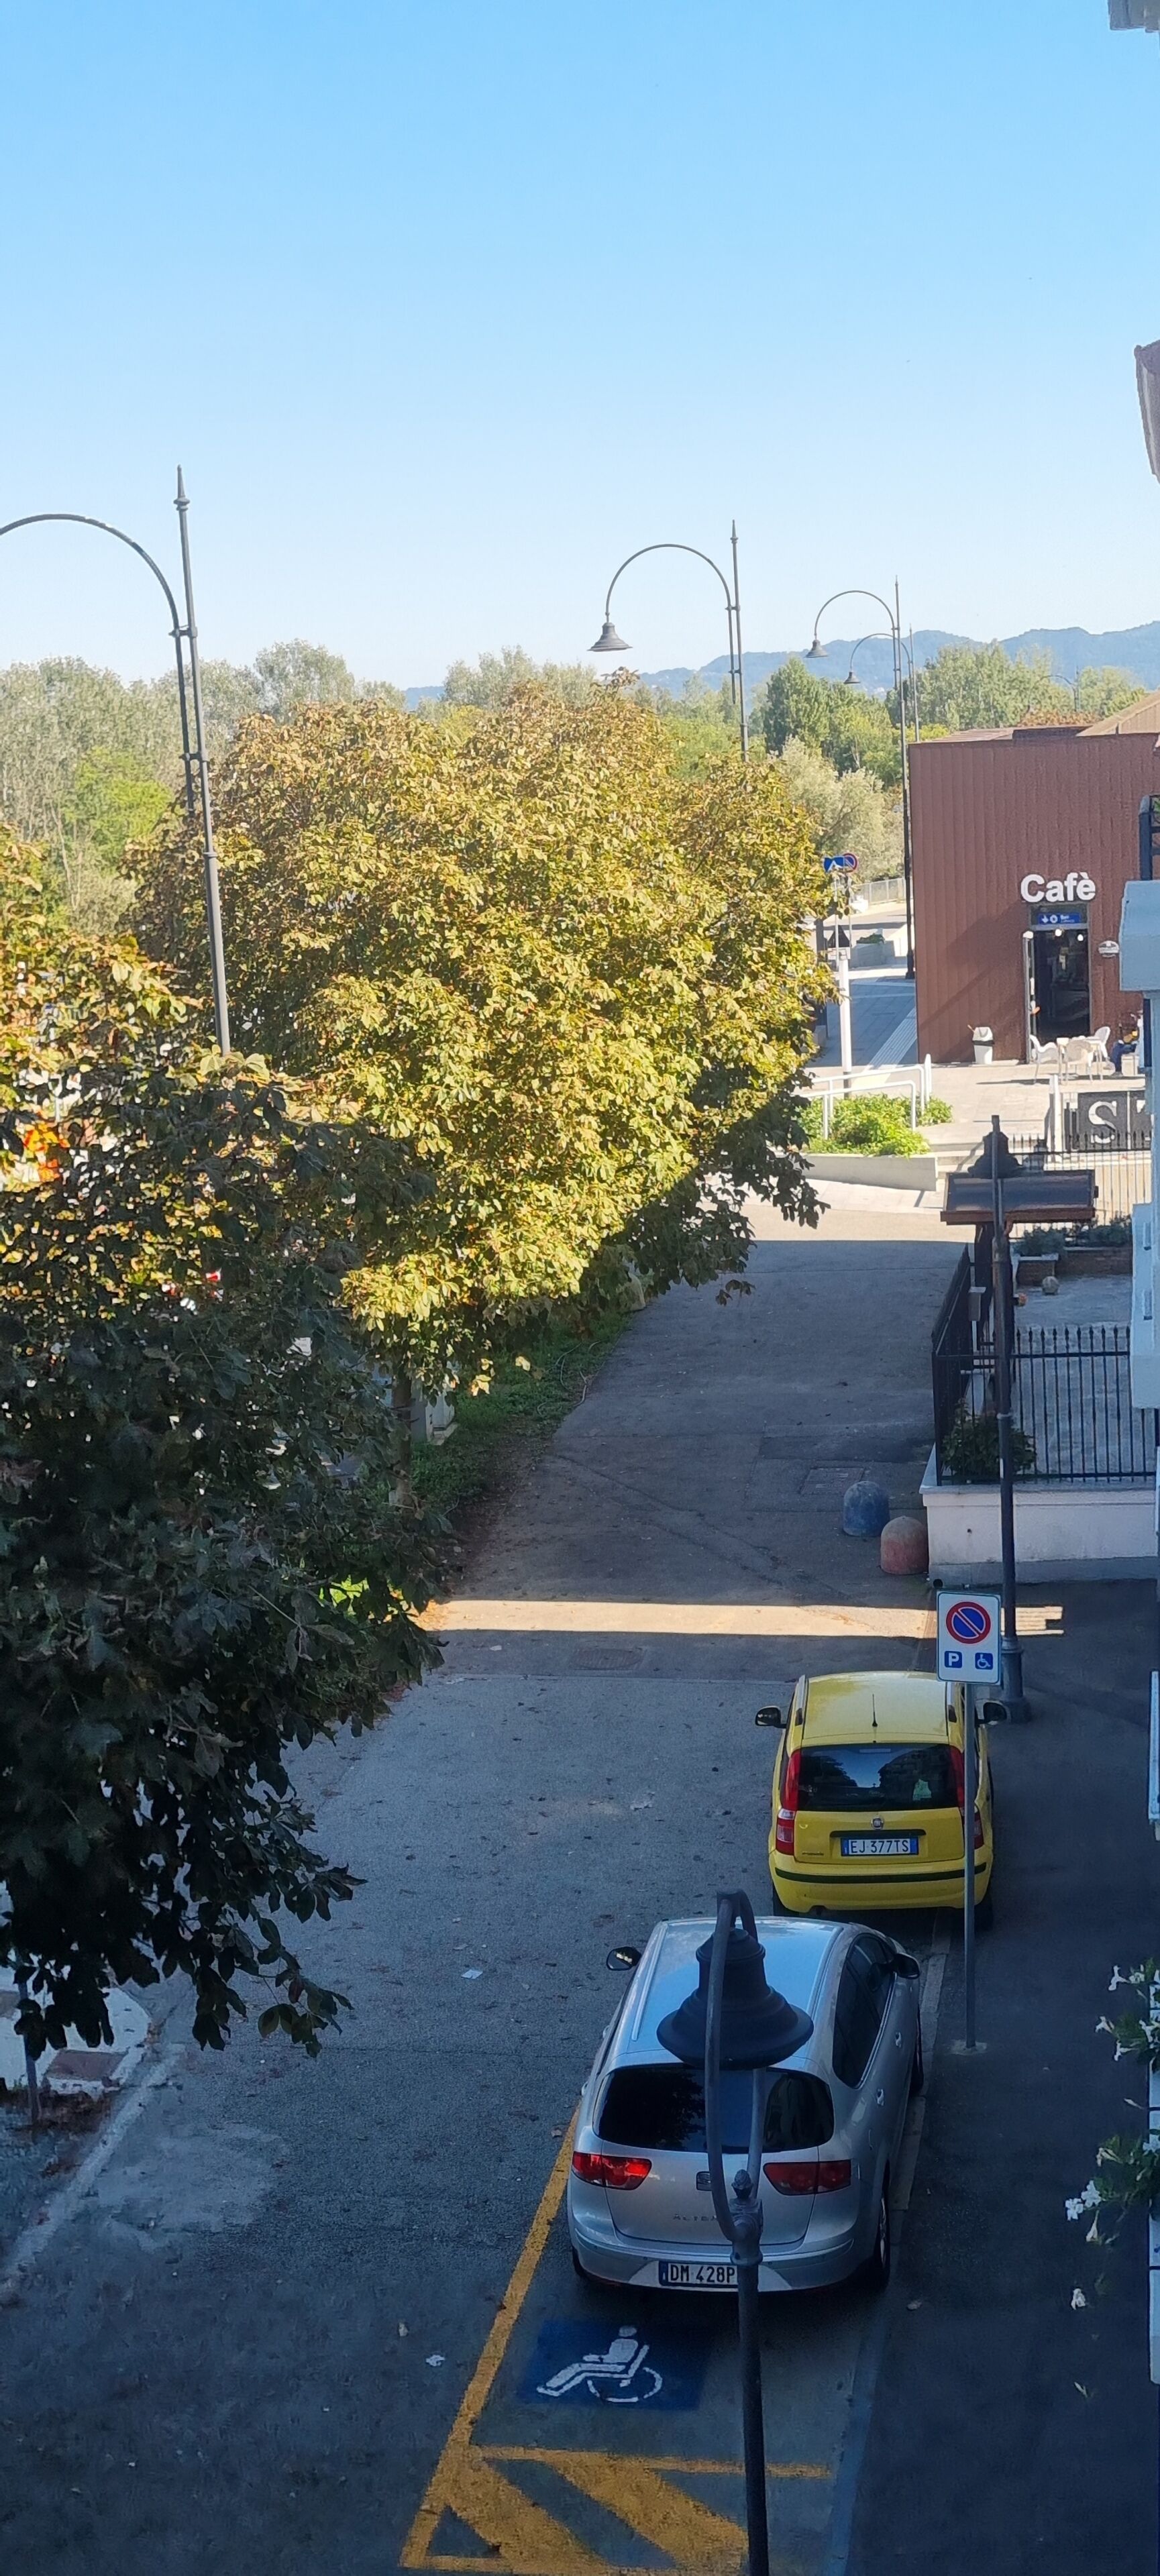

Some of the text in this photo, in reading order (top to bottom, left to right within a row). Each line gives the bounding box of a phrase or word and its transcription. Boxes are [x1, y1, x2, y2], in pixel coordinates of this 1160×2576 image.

[1020, 872, 1096, 903] Cafè
[948, 1652, 959, 1666] P
[850, 1839, 909, 1854] EJ 377TS
[670, 2264, 735, 2284] DM 428P
